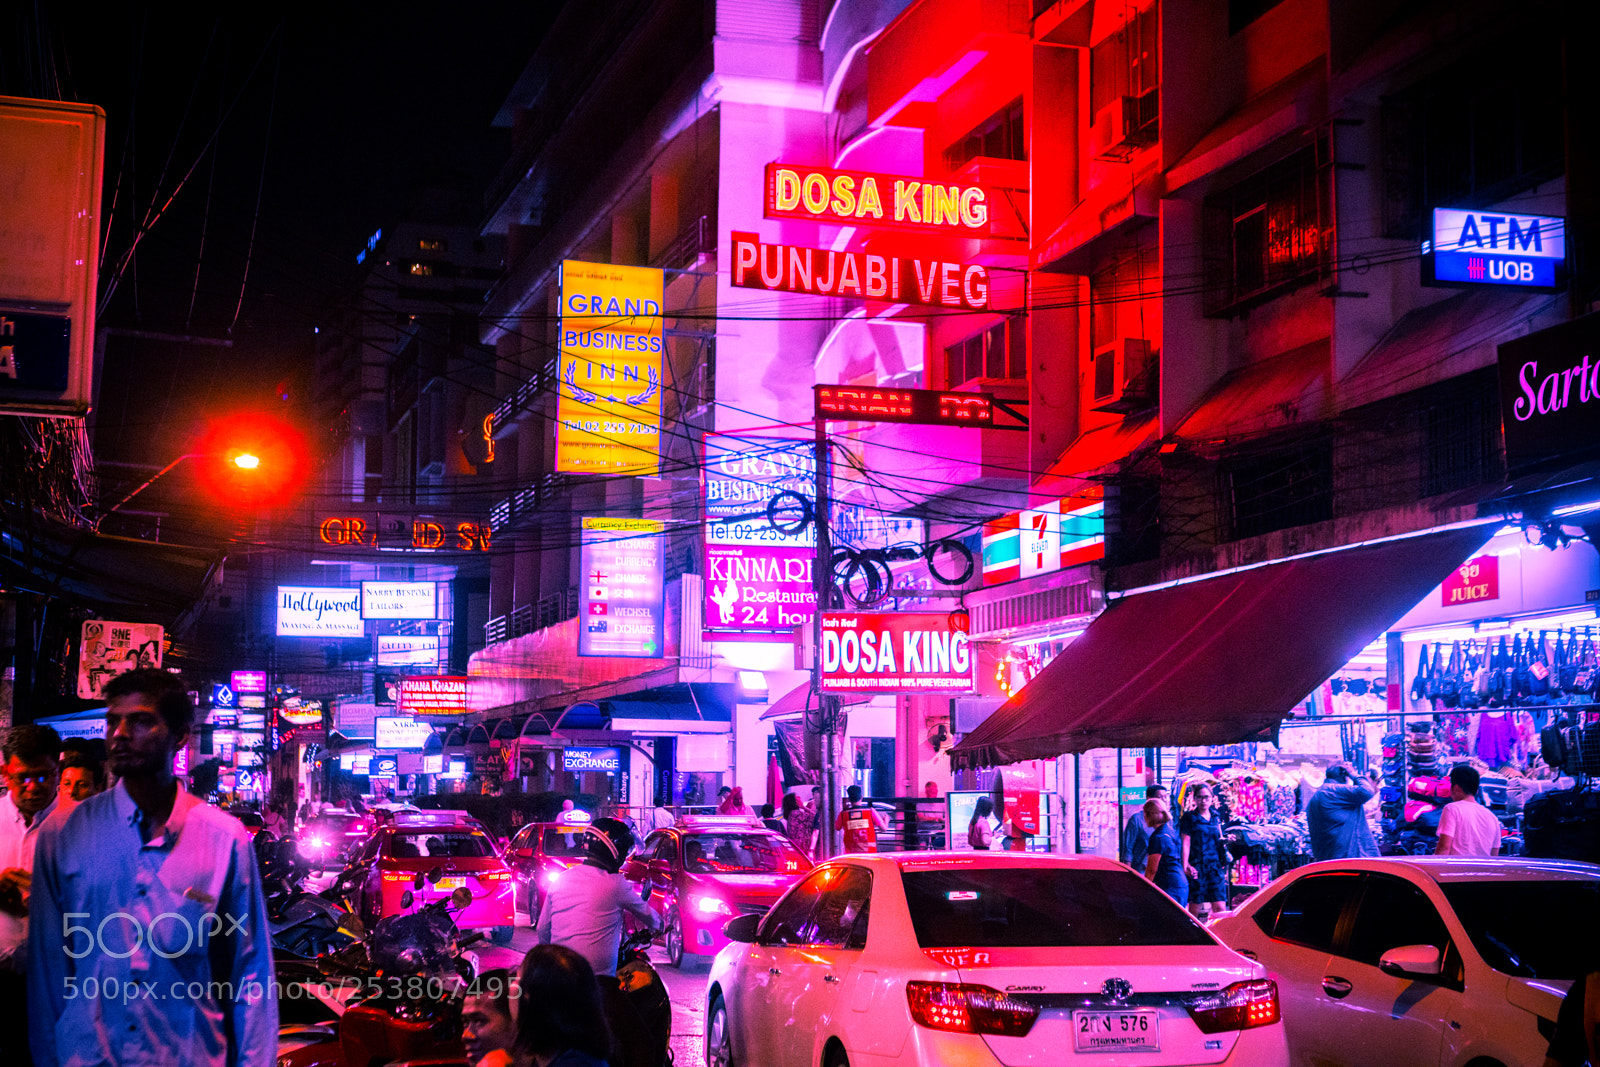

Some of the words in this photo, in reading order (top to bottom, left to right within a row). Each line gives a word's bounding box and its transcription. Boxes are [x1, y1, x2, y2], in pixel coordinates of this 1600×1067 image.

[776, 169, 883, 218] DOSA
[894, 180, 988, 228] KING
[1457, 213, 1542, 252] ATM
[736, 241, 899, 299] PUNJABI
[914, 259, 988, 308] VEG
[1489, 260, 1534, 281] UOB
[568, 294, 660, 318] GRAND
[565, 330, 661, 353] BUSINESS
[586, 362, 639, 382] INN
[563, 420, 600, 432] Tel.02
[604, 422, 625, 433] 255
[708, 480, 793, 502] BUSINESS
[1032, 512, 1048, 540] 7
[615, 540, 656, 550] EXCHANGE
[615, 556, 657, 568] CURRENCY
[708, 557, 814, 583] KINNARI
[614, 573, 648, 584] CHANGE
[1450, 584, 1489, 602] JUICE
[282, 591, 360, 621] Hollywood
[614, 607, 652, 618] WECHSEL
[742, 606, 768, 624] 24
[614, 624, 656, 635] EXCHANGE
[822, 630, 897, 673] DOSA
[903, 630, 970, 673] KING
[402, 680, 430, 692] KHANA
[823, 678, 850, 688] PUNJABI
[850, 678, 856, 688] &
[856, 678, 878, 688] SOUTH
[879, 678, 900, 688] INDIAN
[900, 678, 916, 688] 100%
[564, 750, 592, 758] MONEY
[564, 758, 619, 768] EXCHANGE
[620, 772, 628, 802] Exchange
[1120, 1016, 1148, 1032] 576
